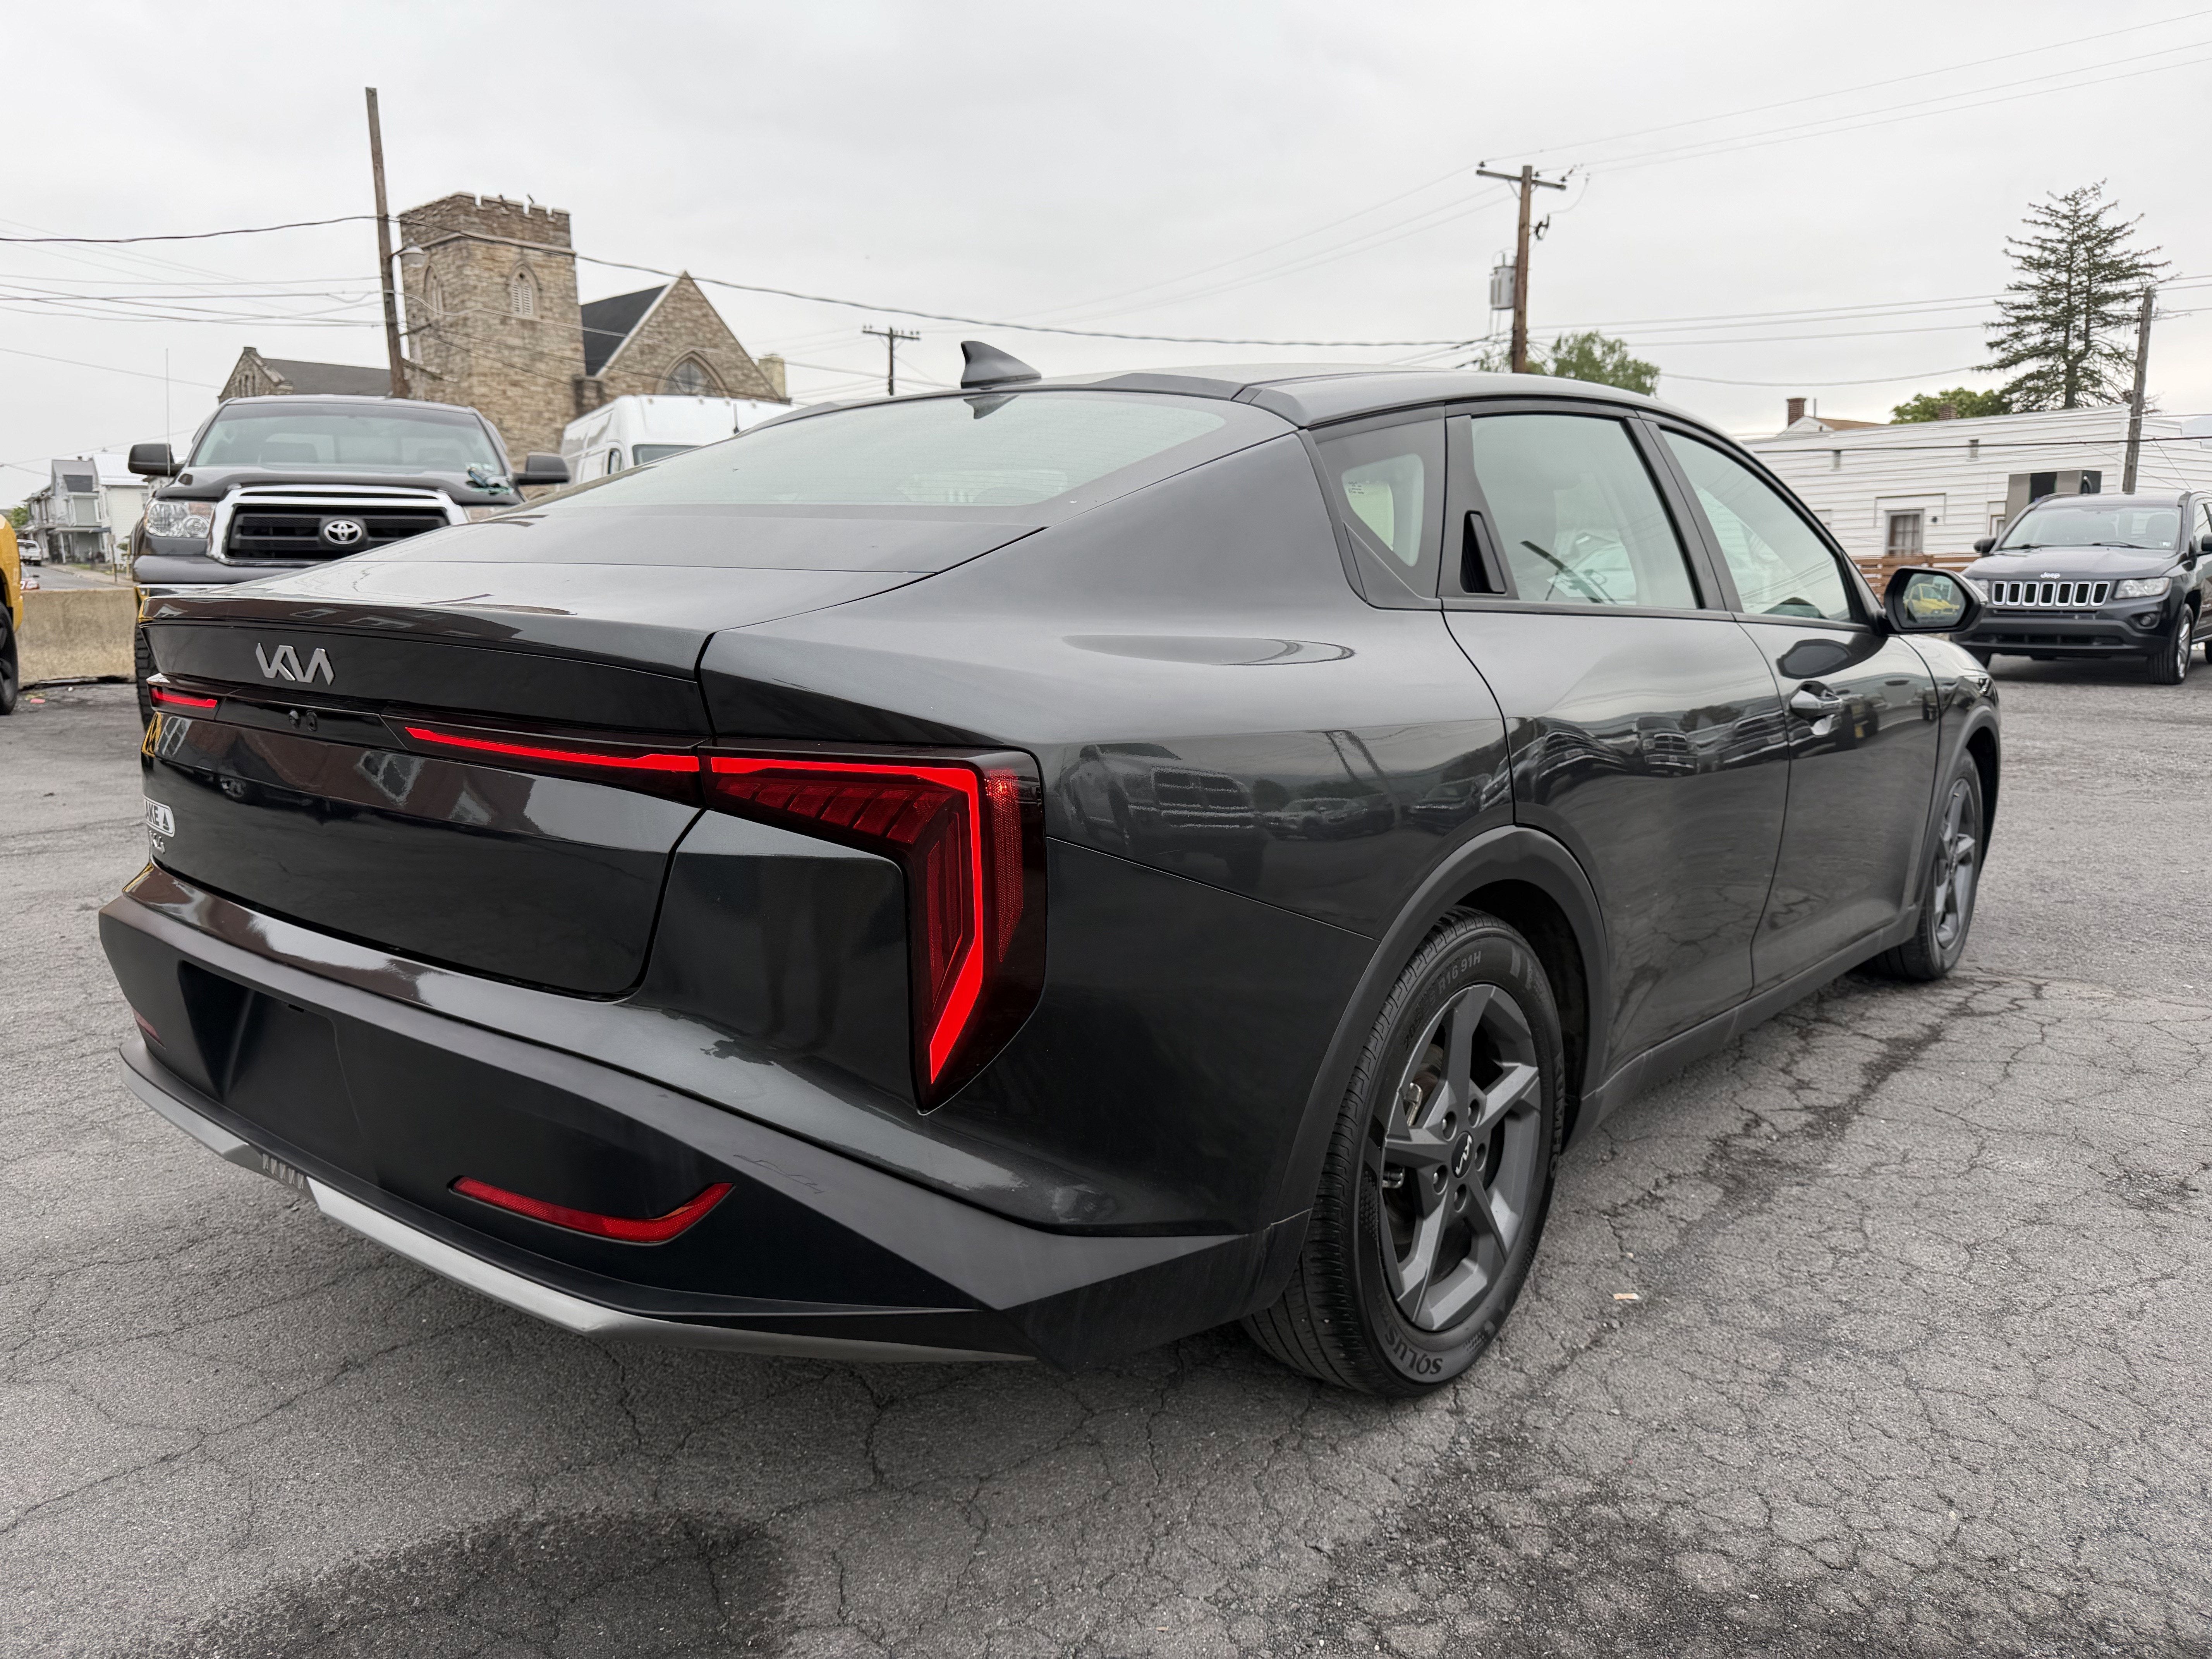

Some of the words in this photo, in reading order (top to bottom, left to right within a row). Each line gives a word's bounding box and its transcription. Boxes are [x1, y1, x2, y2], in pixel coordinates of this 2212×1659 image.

[256, 642, 335, 686] KIA
[1461, 951, 1481, 972] 91H
[1385, 1325, 1443, 1375] SOLUS
